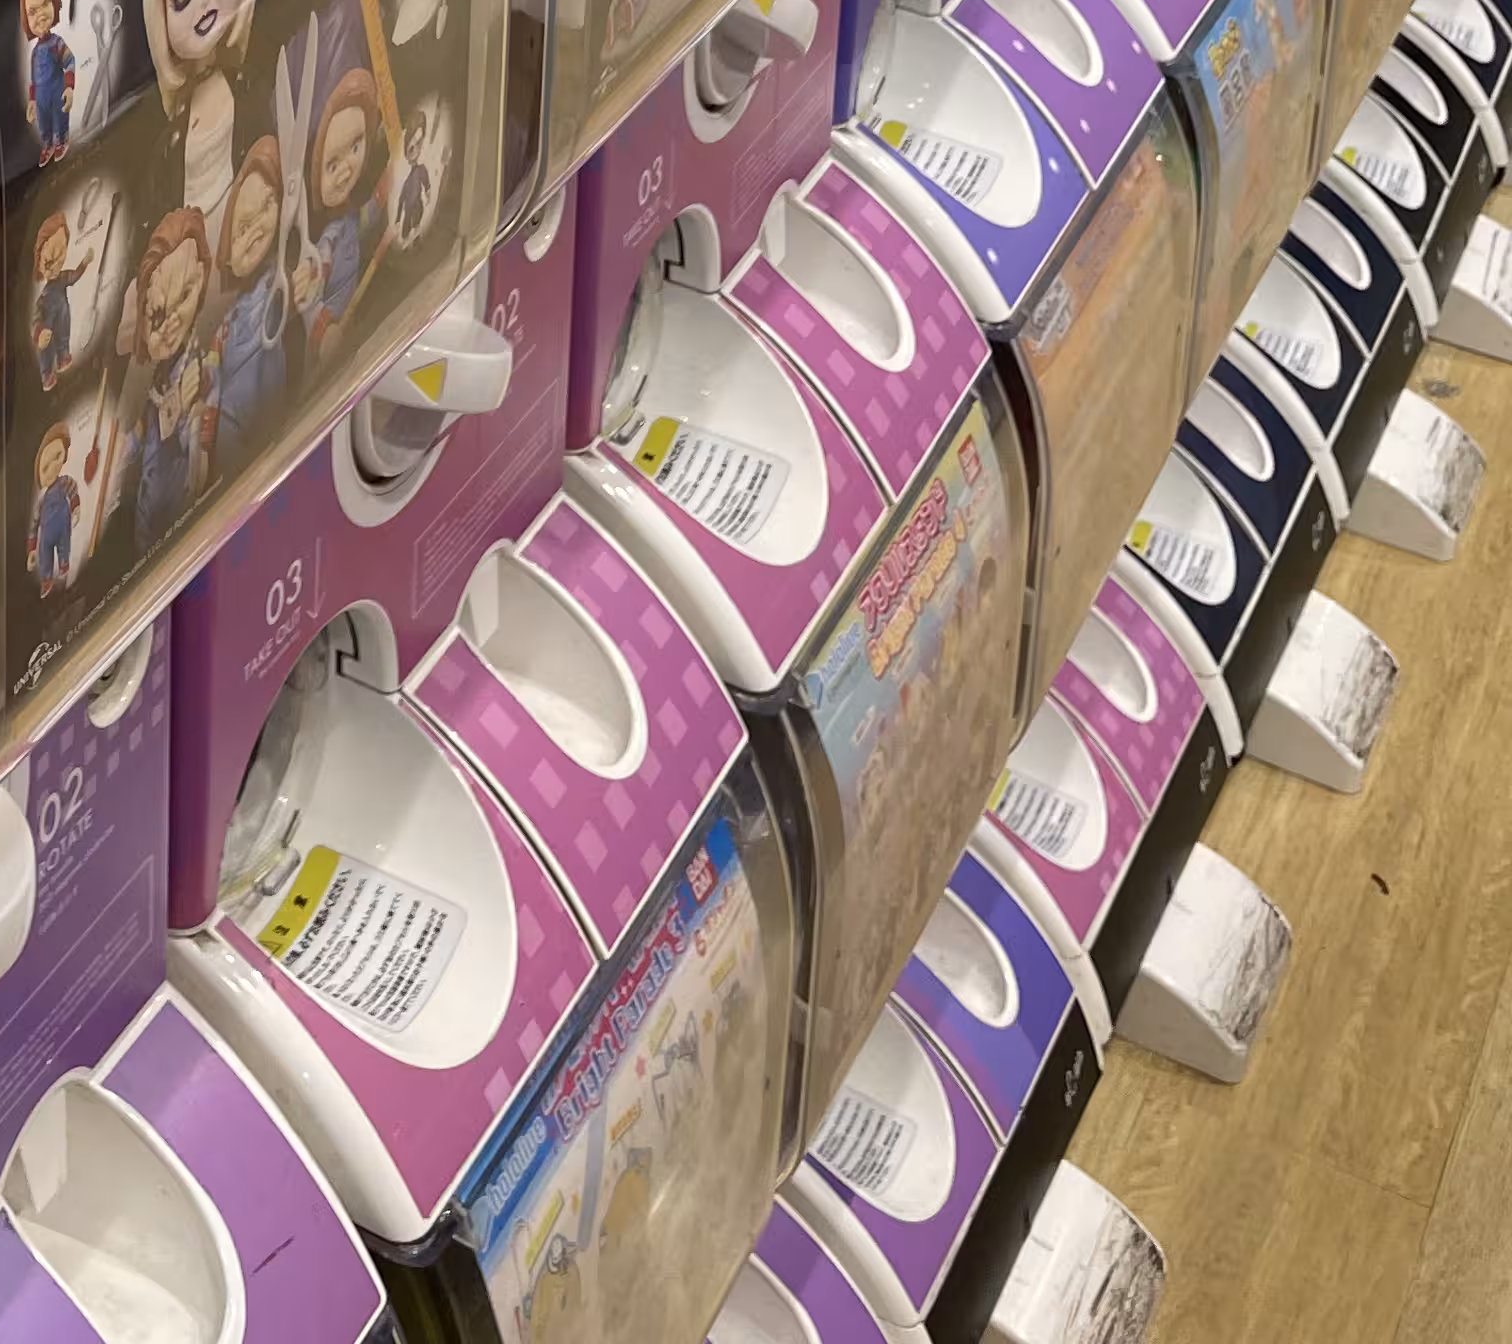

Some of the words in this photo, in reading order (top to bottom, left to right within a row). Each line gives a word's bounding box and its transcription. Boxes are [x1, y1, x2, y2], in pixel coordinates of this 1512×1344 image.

[638, 156, 664, 207] 03
[265, 558, 302, 626] 03
[244, 632, 273, 681] TAKE
[38, 766, 85, 845] 02
[555, 1043, 616, 1143] Bright
